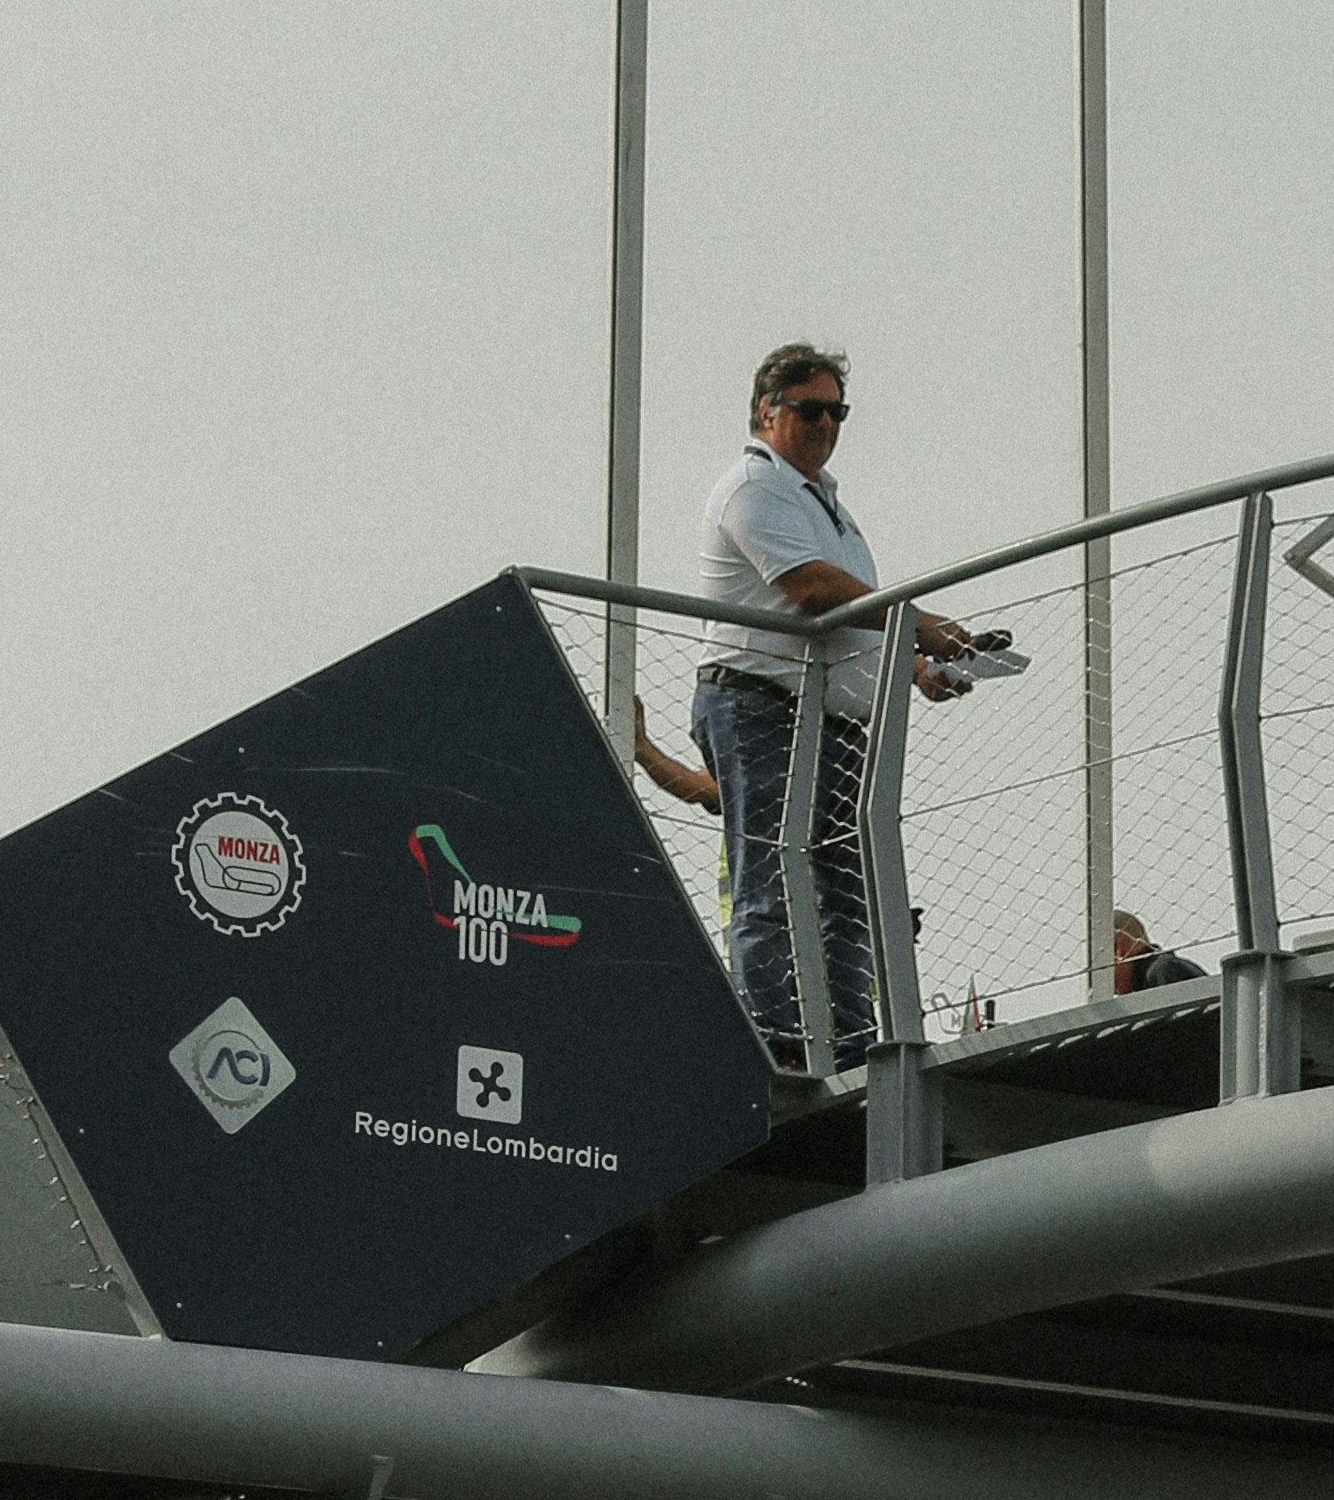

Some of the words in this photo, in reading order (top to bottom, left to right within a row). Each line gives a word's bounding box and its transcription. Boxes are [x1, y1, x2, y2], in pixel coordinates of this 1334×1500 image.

[217, 836, 280, 866] MONZA
[453, 880, 548, 928] MONZA
[454, 917, 508, 967] 100
[207, 1046, 271, 1087] ACI
